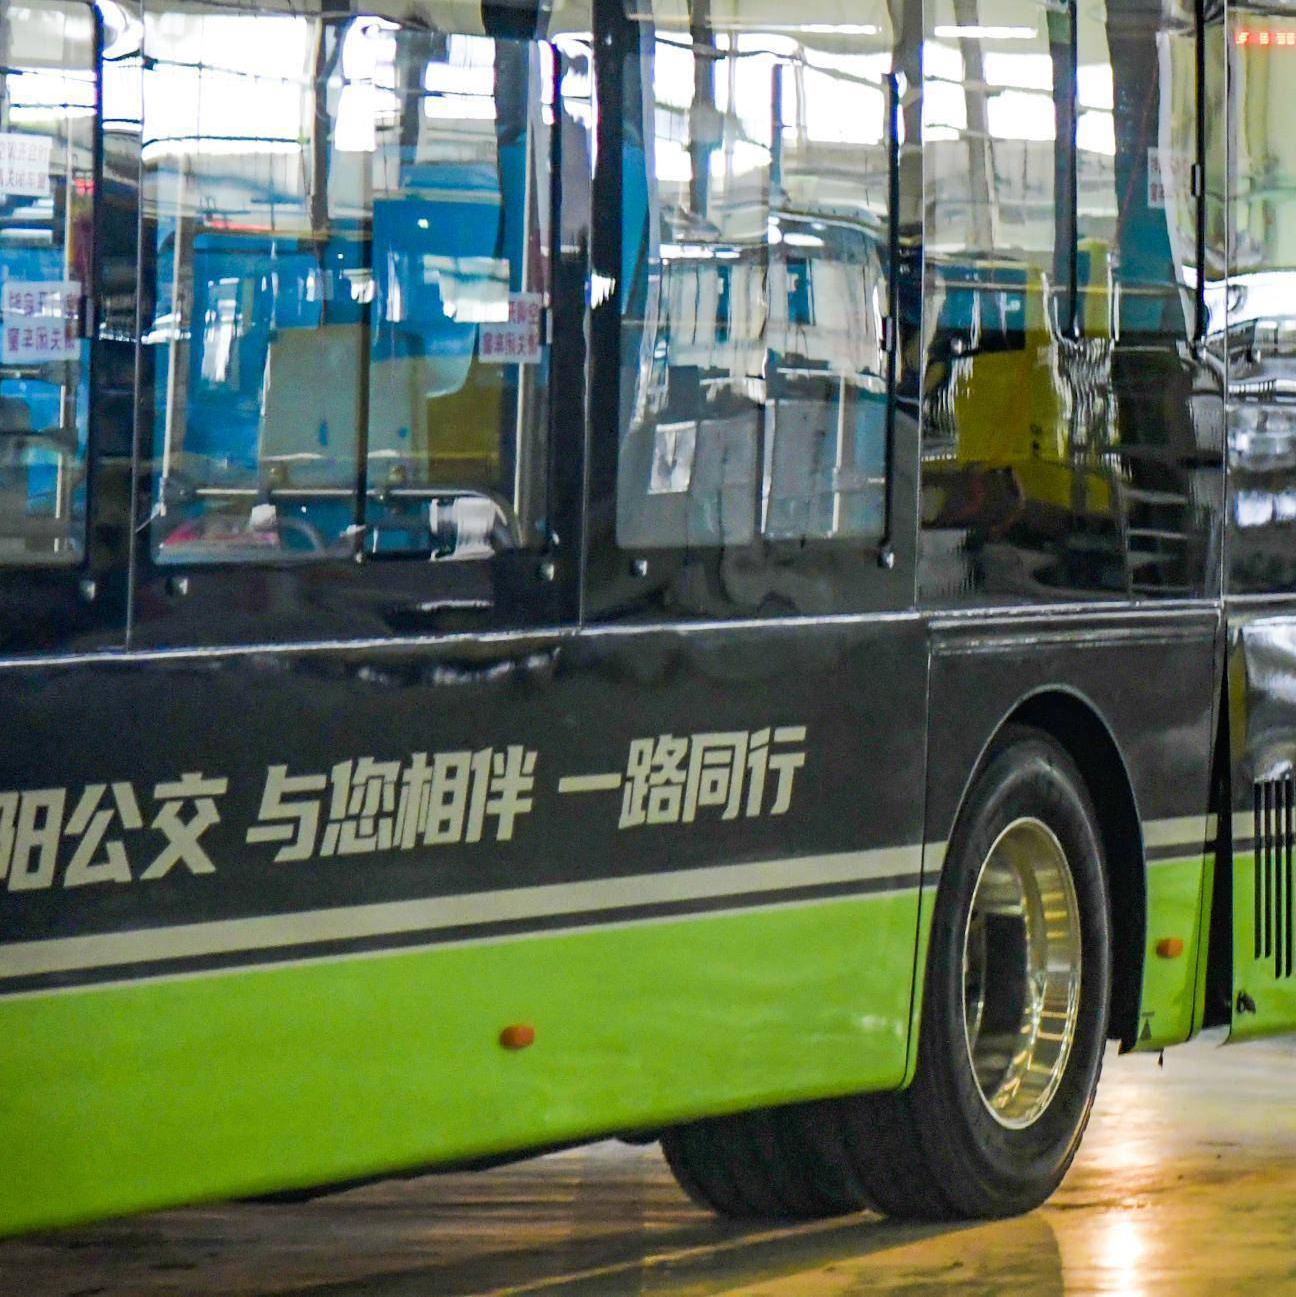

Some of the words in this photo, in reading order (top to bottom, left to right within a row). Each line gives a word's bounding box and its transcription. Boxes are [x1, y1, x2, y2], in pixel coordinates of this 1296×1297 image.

[0, 772, 229, 892] 阳公交
[246, 745, 538, 863] 与您相伴
[558, 725, 807, 830] 一路同行
